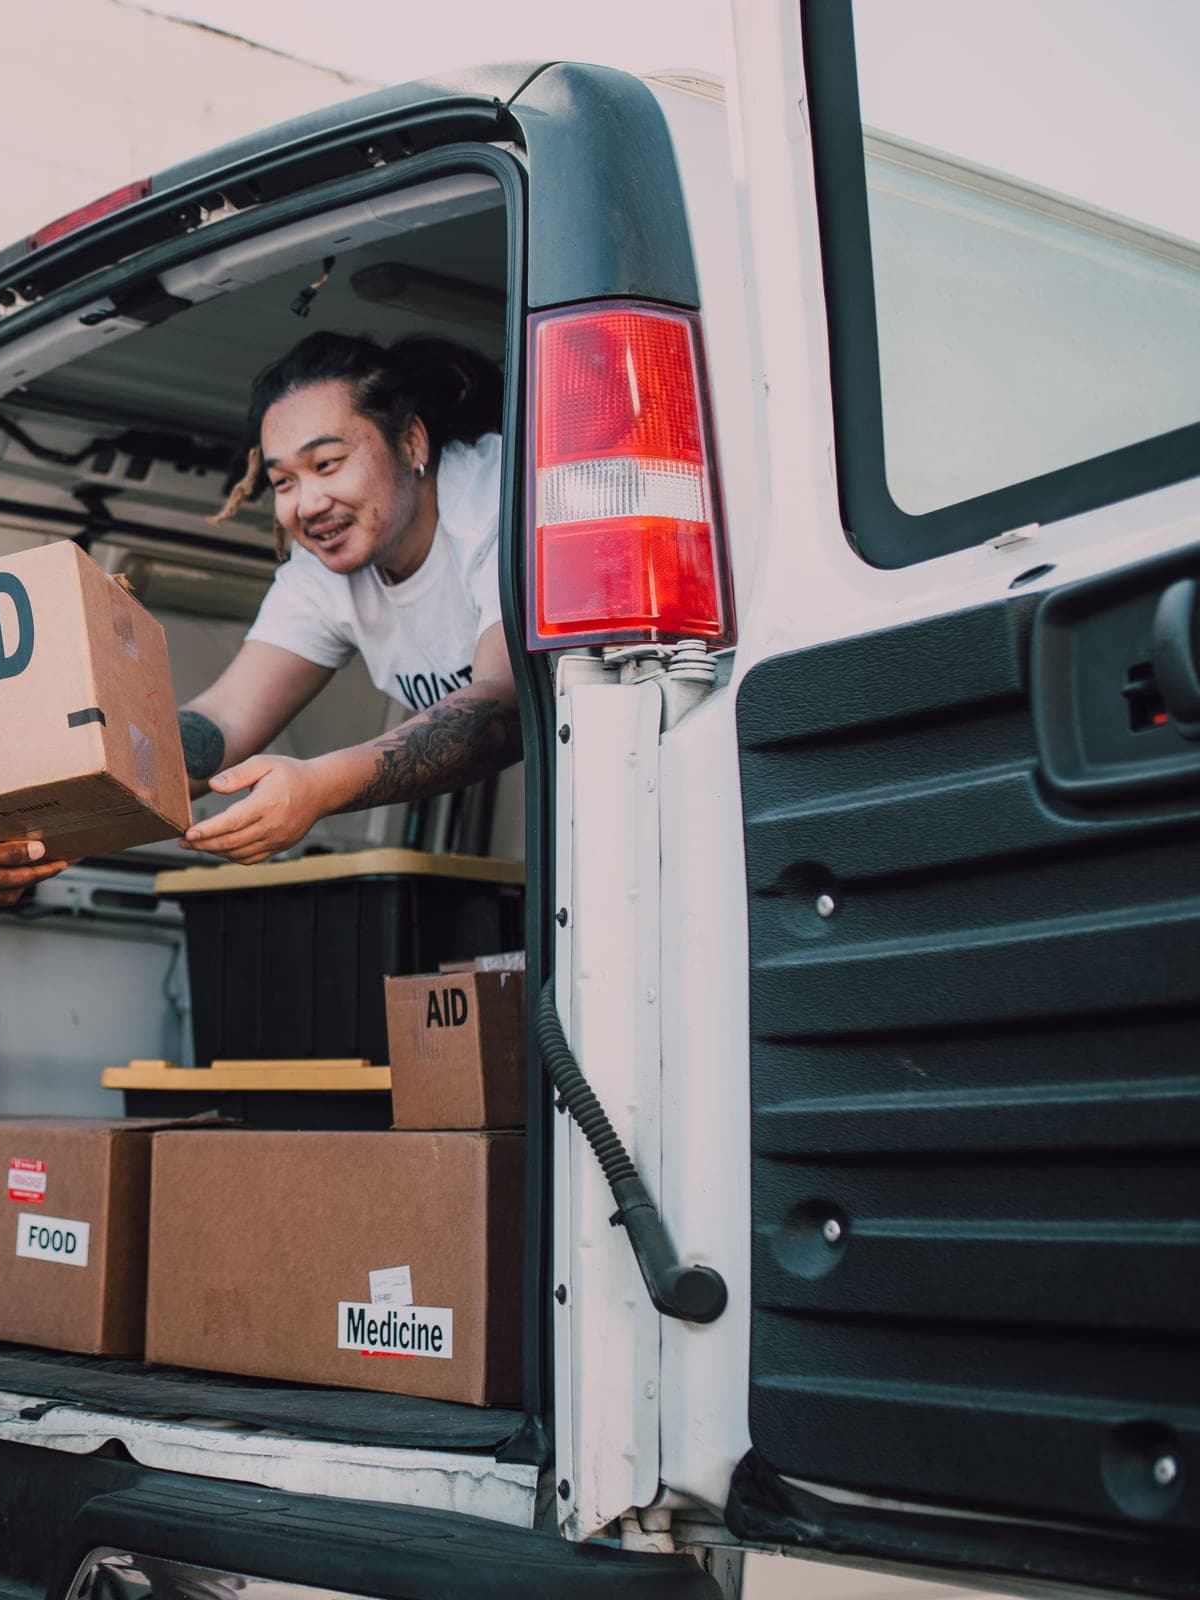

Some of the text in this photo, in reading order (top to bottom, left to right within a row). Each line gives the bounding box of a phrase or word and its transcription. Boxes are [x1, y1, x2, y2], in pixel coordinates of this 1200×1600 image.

[426, 987, 469, 1028] AID
[28, 1225, 77, 1254] FOOD
[347, 1307, 443, 1352] Medicine
